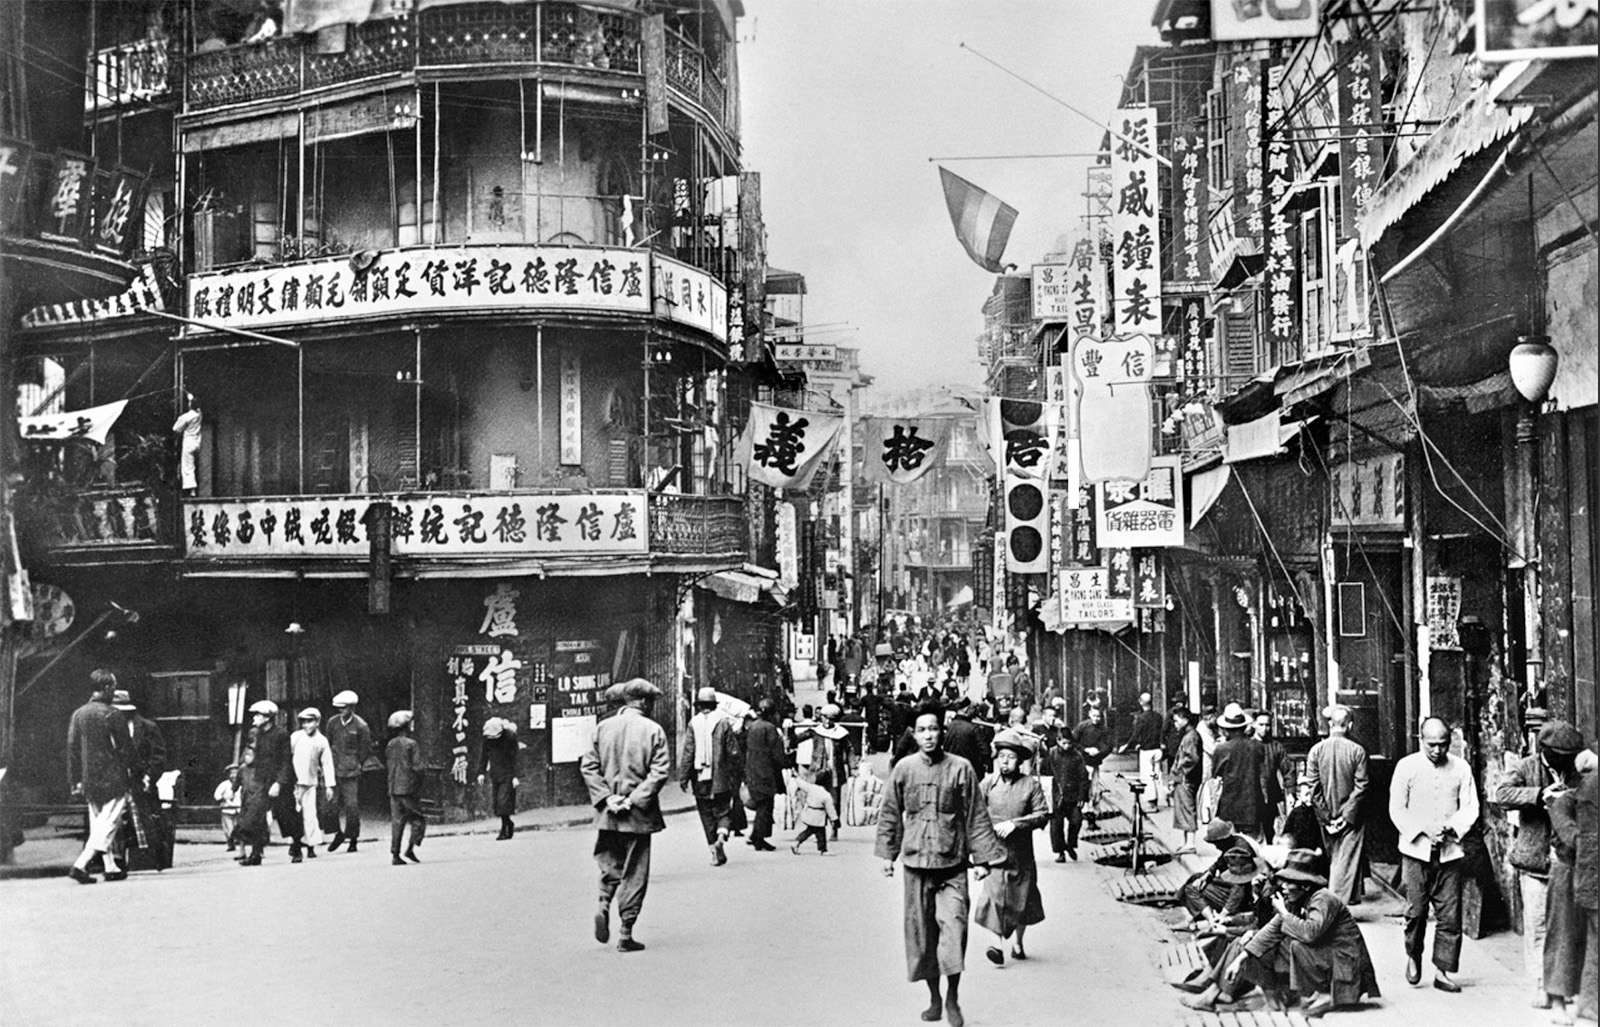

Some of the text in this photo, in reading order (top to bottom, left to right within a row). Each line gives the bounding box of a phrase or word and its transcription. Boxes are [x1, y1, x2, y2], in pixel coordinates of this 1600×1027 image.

[1115, 118, 1157, 326] 振威鐘表
[1105, 510, 1176, 532] 電器雜貨
[1070, 572, 1102, 588] 生昌
[1079, 610, 1114, 618] TAILORS
[558, 677, 571, 692] LO
[569, 692, 589, 705] TAK
